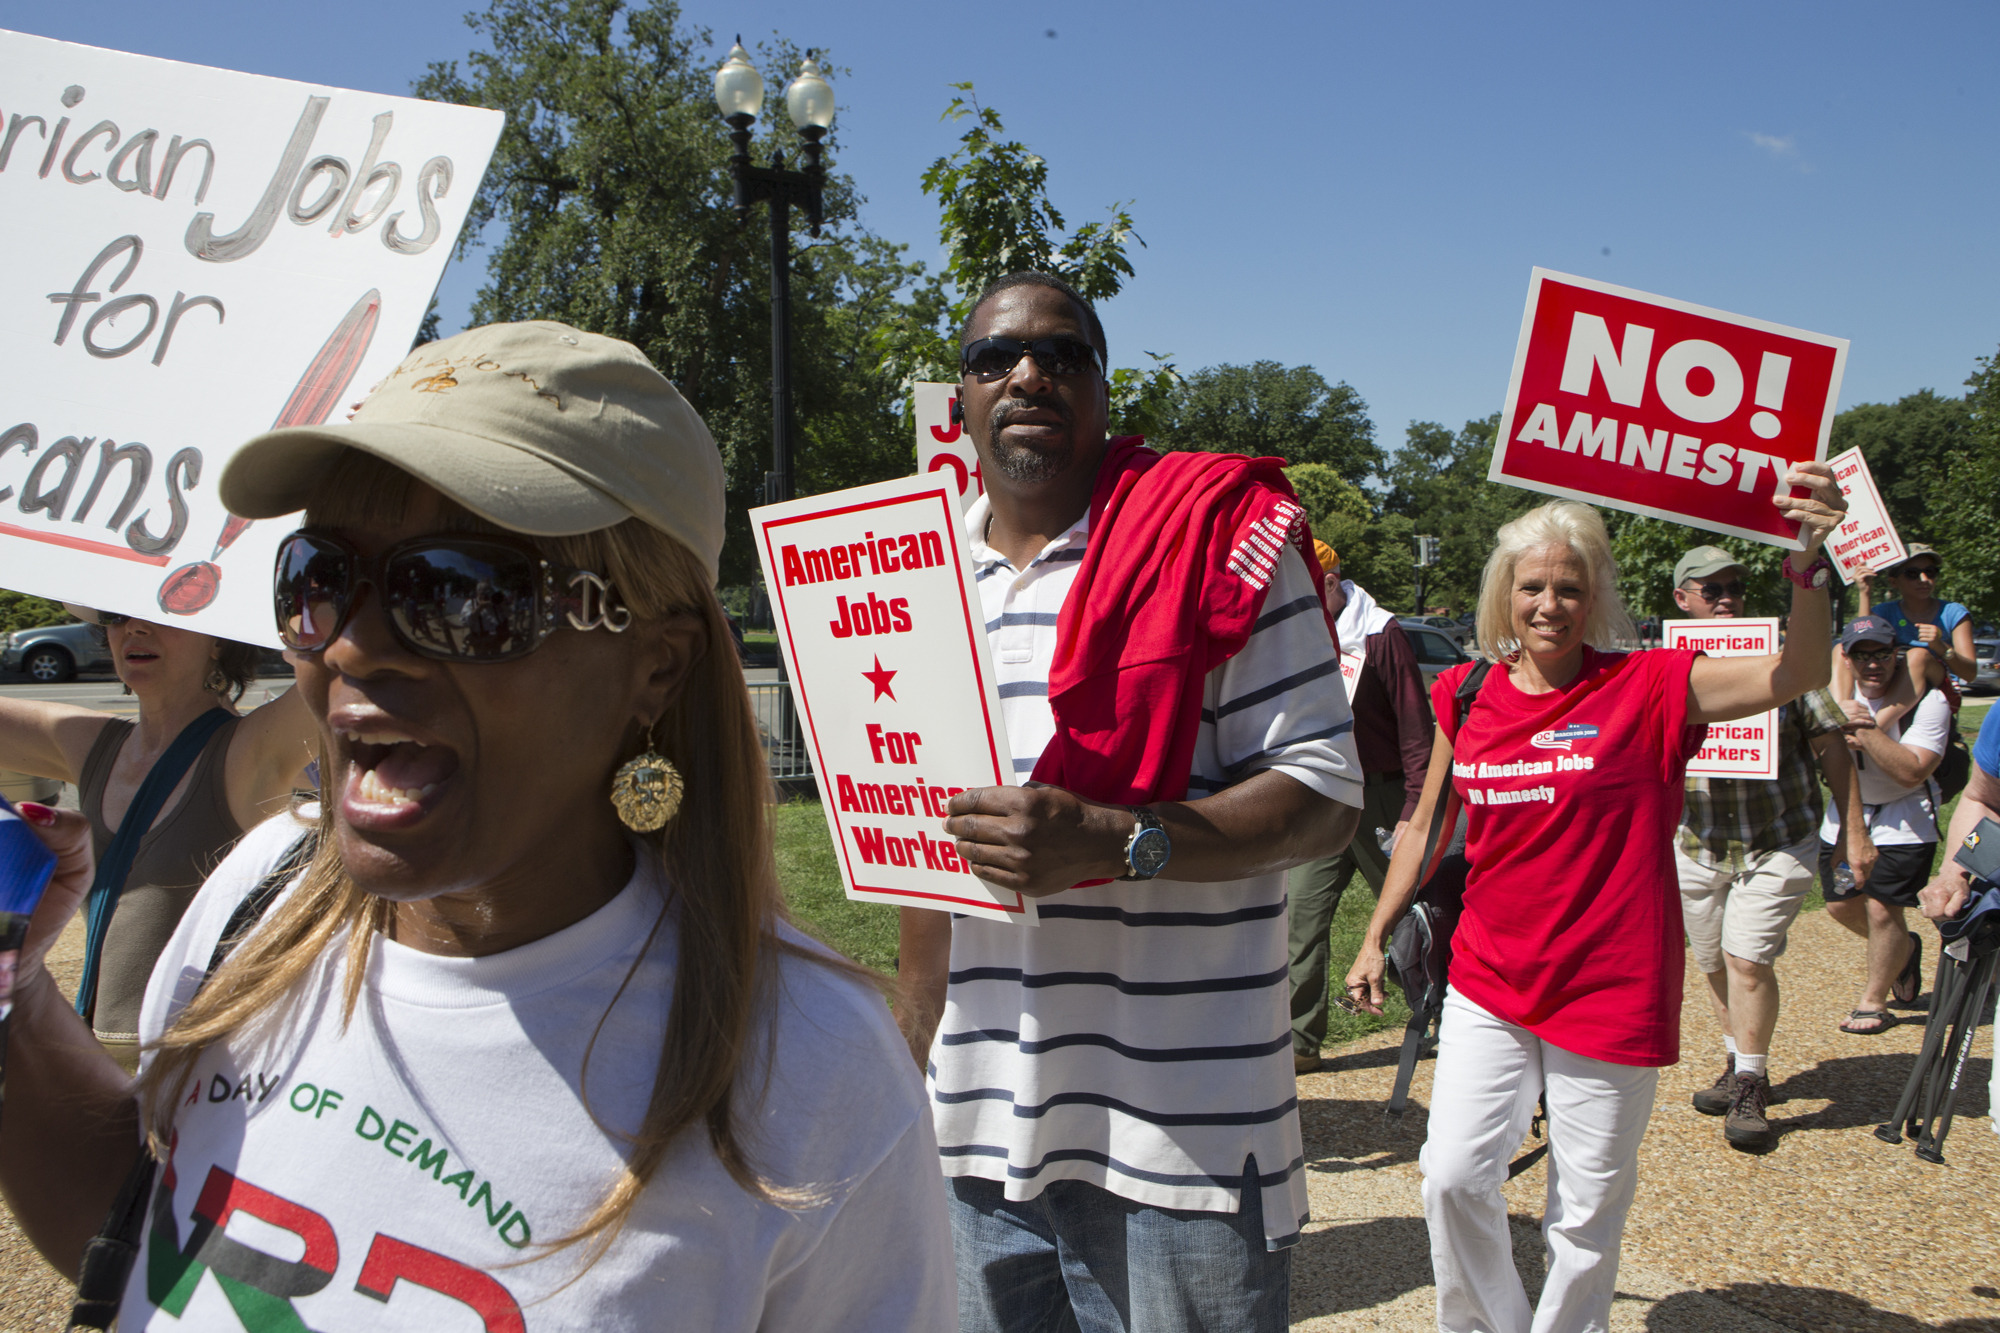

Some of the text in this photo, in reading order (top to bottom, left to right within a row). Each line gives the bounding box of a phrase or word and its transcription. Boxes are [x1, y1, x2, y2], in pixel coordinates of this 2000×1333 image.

[0, 84, 455, 263] rican Jobs
[46, 234, 226, 366] for
[1559, 310, 1793, 439] NO!
[1515, 402, 1799, 498] AMNESTY
[1834, 526, 1886, 557] American
[1840, 520, 1860, 536] For
[781, 530, 946, 587] American
[1841, 542, 1891, 571] Workers
[1227, 560, 1264, 591] MISSOURI
[829, 591, 913, 639] Jobs
[1853, 619, 1874, 633] USA
[1676, 634, 1764, 650] American
[865, 723, 922, 765] For
[1697, 745, 1760, 761] orkers
[1478, 759, 1553, 778] American
[1556, 754, 1594, 771] Jobs
[1487, 785, 1555, 805] Amnesty
[208, 1072, 279, 1103] DAY
[289, 1082, 343, 1119] OF
[355, 1105, 531, 1249] DEMAND
